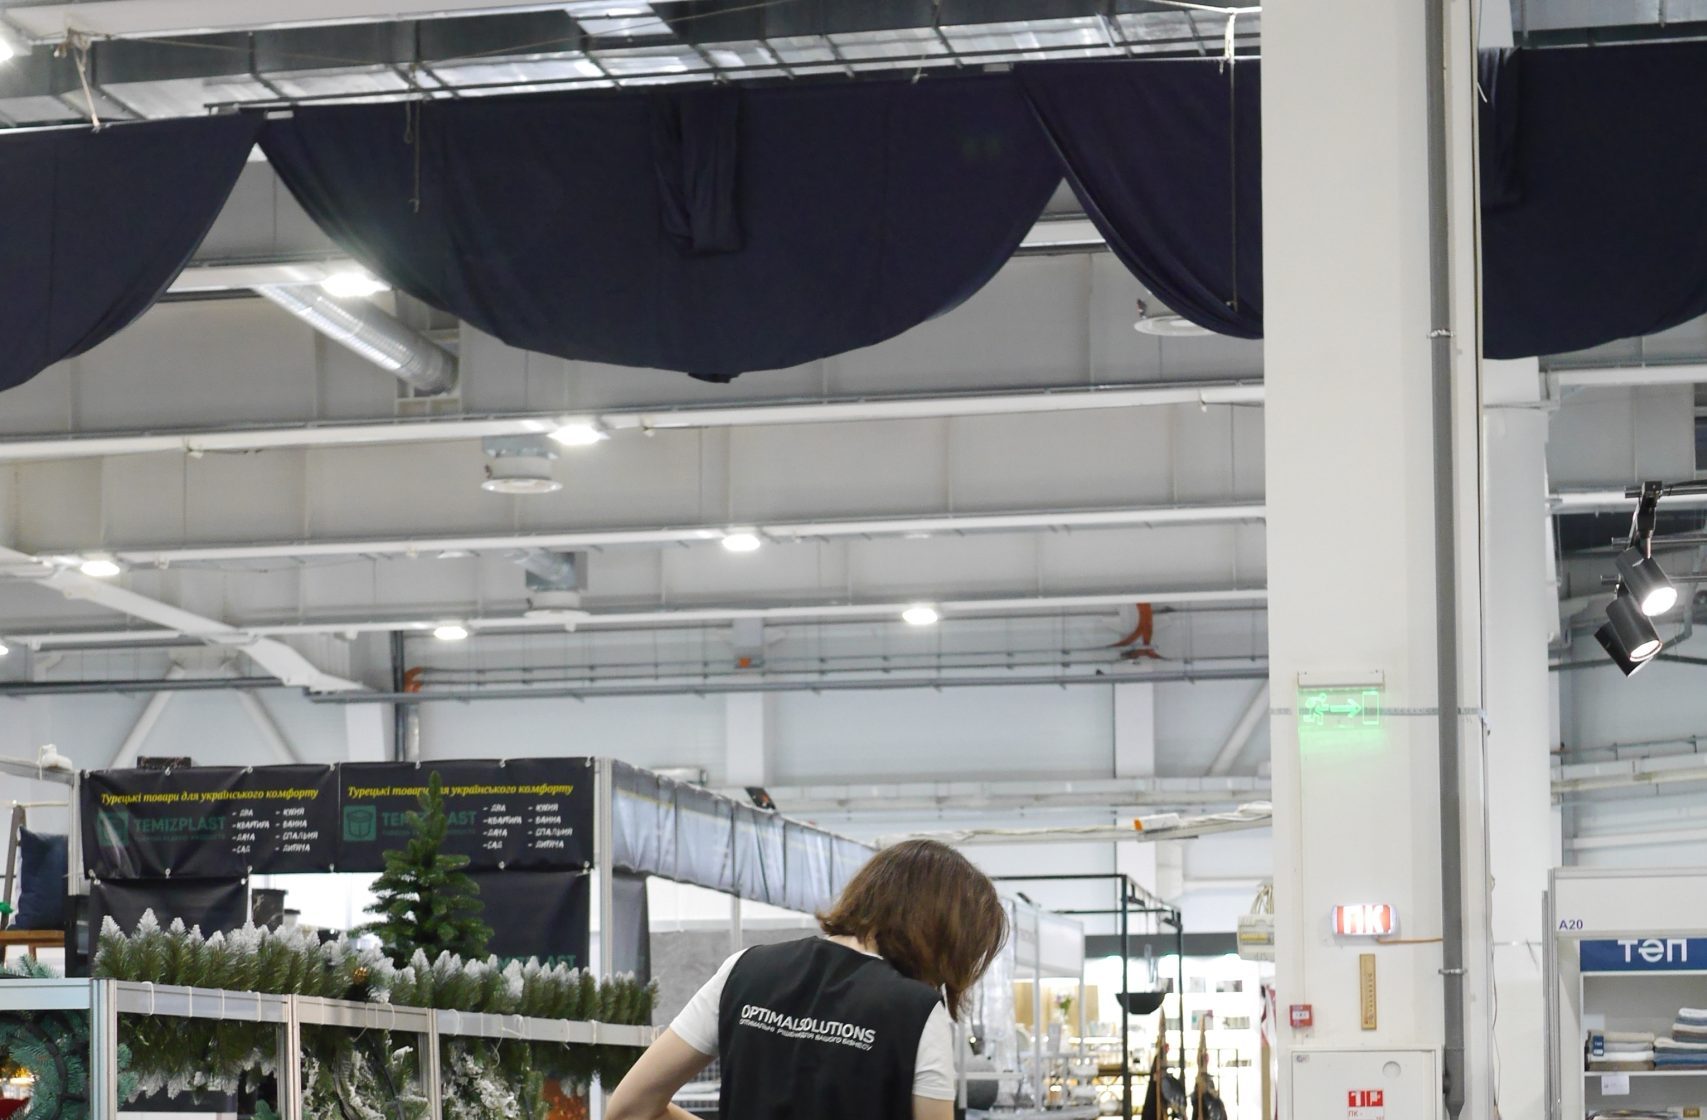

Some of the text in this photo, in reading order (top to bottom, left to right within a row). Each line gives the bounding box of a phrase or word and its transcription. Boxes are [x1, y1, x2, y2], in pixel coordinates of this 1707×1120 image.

[101, 788, 319, 805] Турецькі товари для українського комфорту
[348, 786, 391, 798] Турецькі
[451, 785, 517, 797] українського
[518, 783, 574, 796] комфорту
[134, 816, 226, 832] TEMIZPLAST
[282, 831, 319, 841] СПАЛЬНЯ
[1558, 919, 1584, 930] A20
